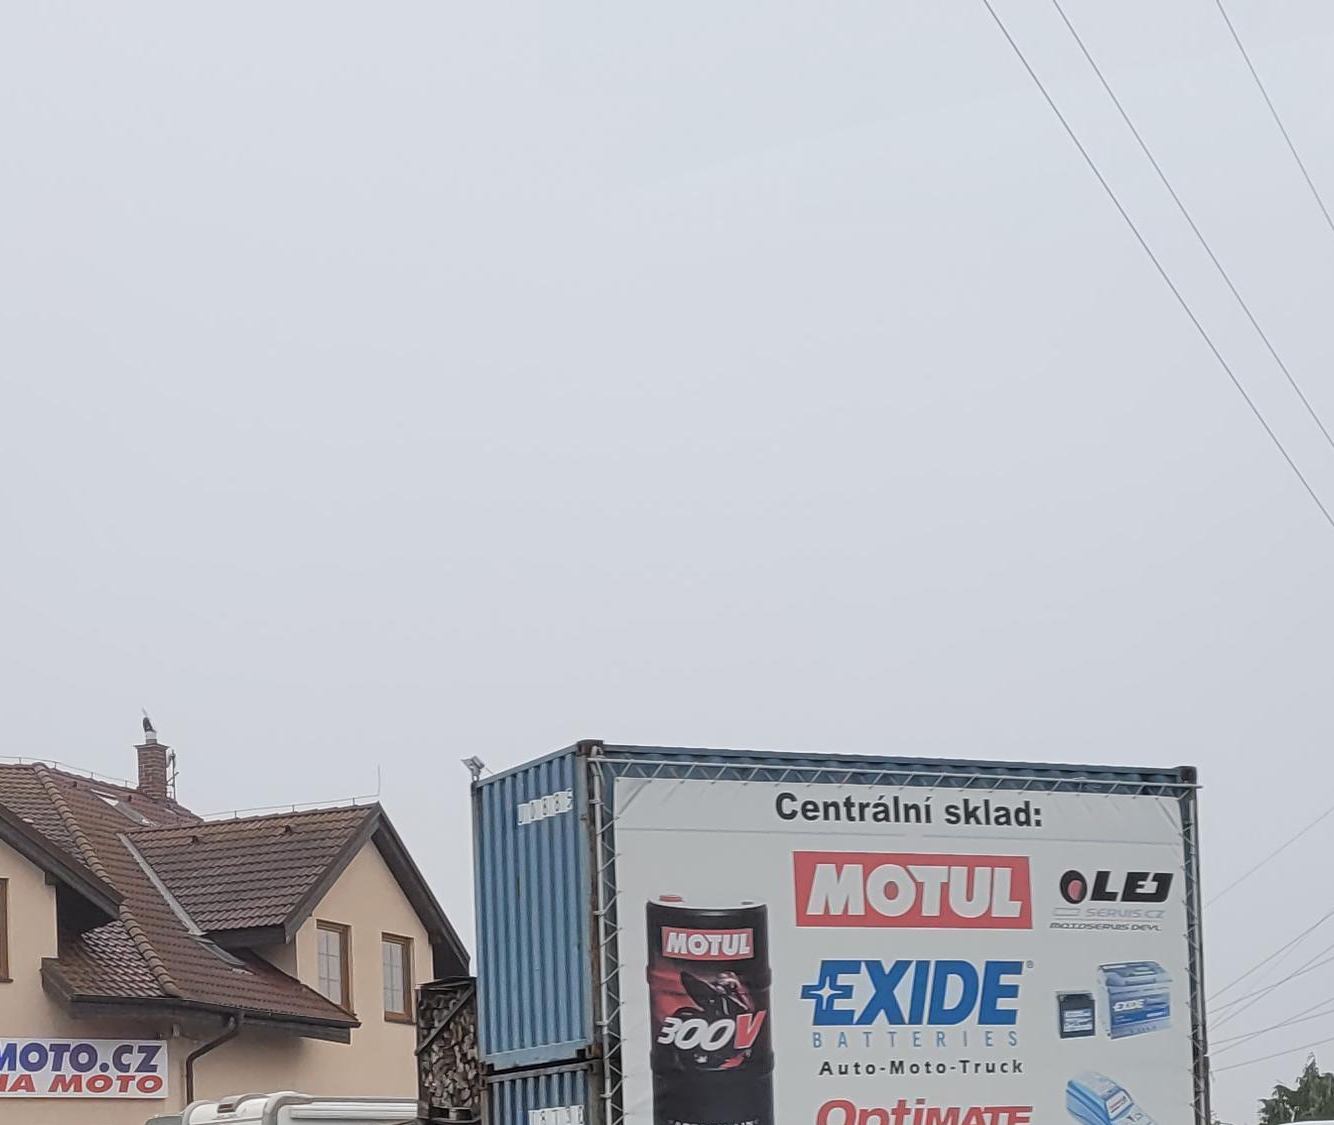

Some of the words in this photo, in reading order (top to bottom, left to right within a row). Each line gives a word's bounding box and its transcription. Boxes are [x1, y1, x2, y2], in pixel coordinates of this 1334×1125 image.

[776, 792, 932, 824] Centrální
[944, 798, 1043, 828] sklad:
[805, 862, 1023, 919] MOTUL
[1059, 869, 1175, 905] OLEJ
[665, 932, 751, 956] MOTUL
[800, 959, 1025, 1026] EXIDE
[657, 1010, 767, 1051] 300V
[812, 1030, 1019, 1048] BATTERIES
[48, 1074, 164, 1094] MOTO
[818, 1058, 1025, 1075] Auto-Moto-Truck
